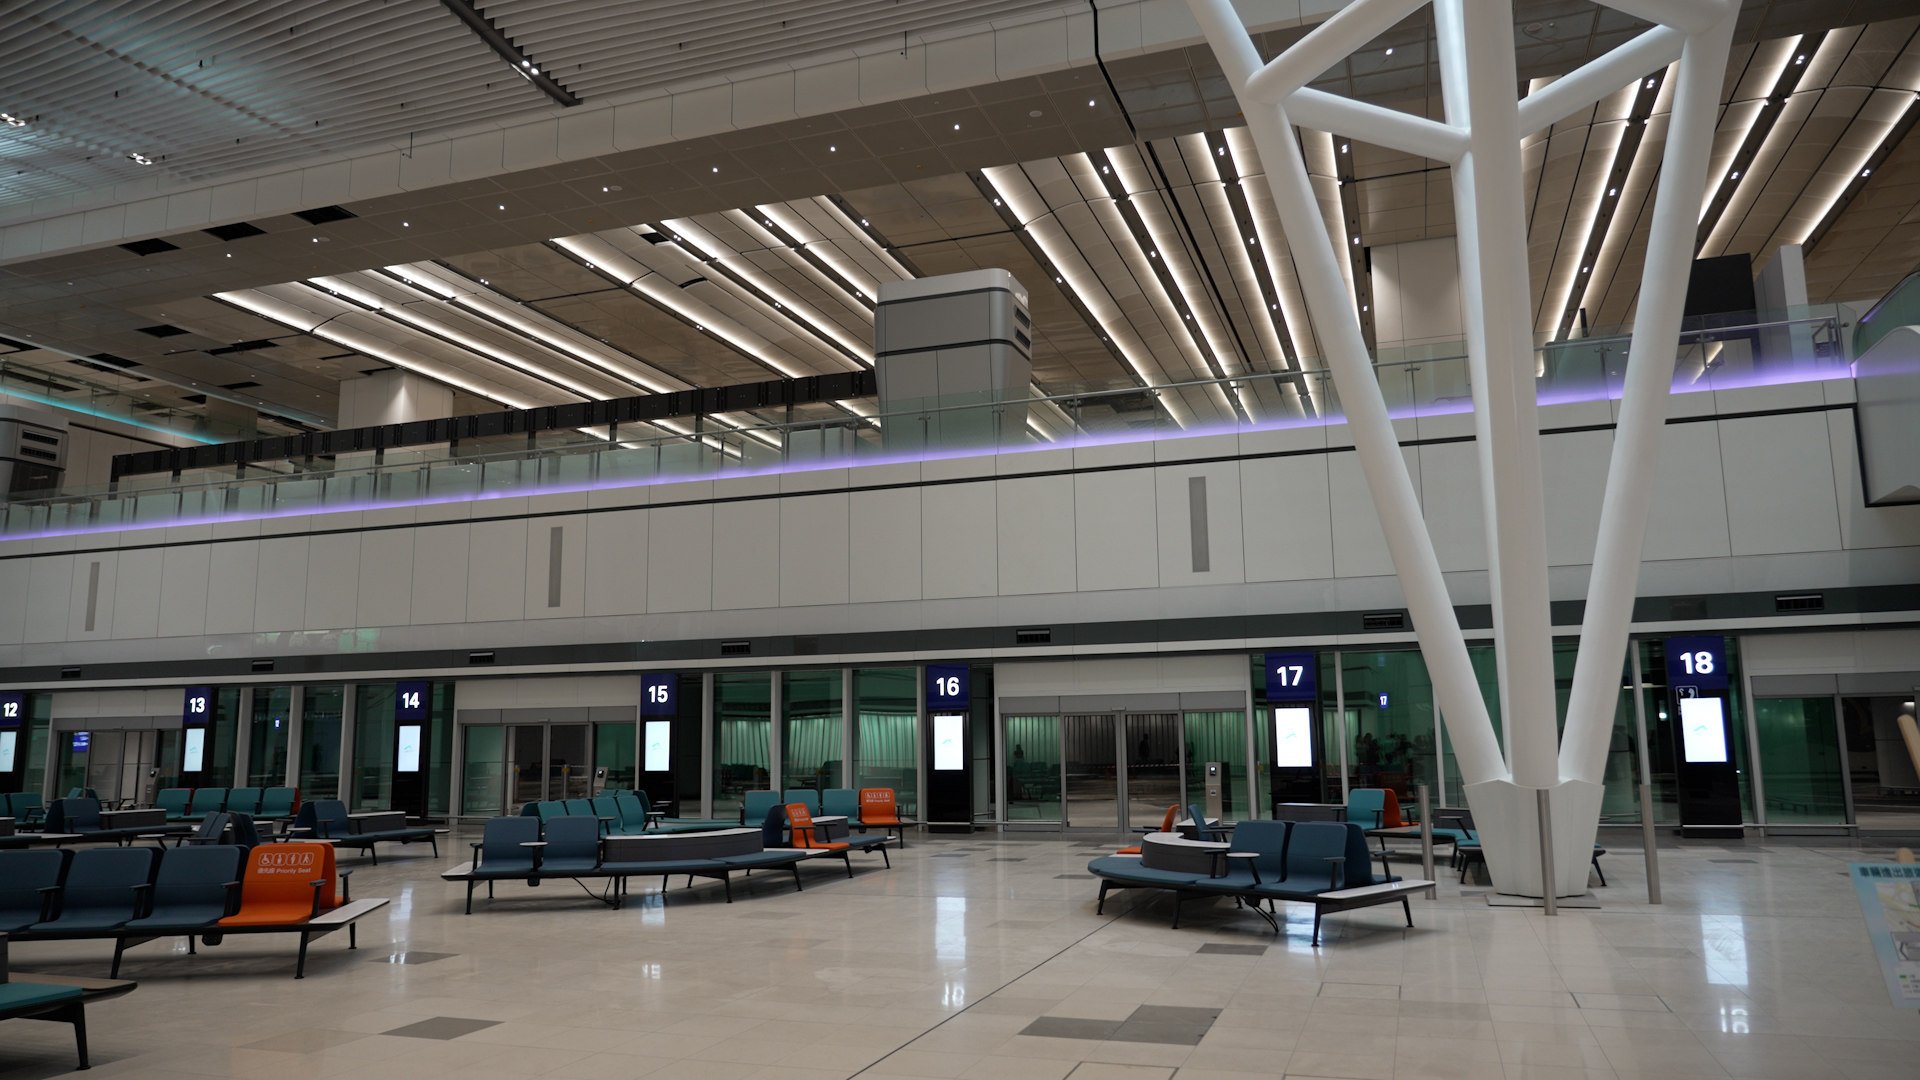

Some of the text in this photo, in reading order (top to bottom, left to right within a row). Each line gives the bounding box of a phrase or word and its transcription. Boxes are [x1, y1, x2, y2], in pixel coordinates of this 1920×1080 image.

[1680, 652, 1713, 674] 18
[1277, 666, 1303, 686] 17
[648, 686, 669, 702] 15
[936, 677, 959, 696] 16
[190, 697, 205, 713] 13
[402, 692, 419, 708] 14
[1380, 696, 1388, 705] 17
[4, 702, 18, 717] 12
